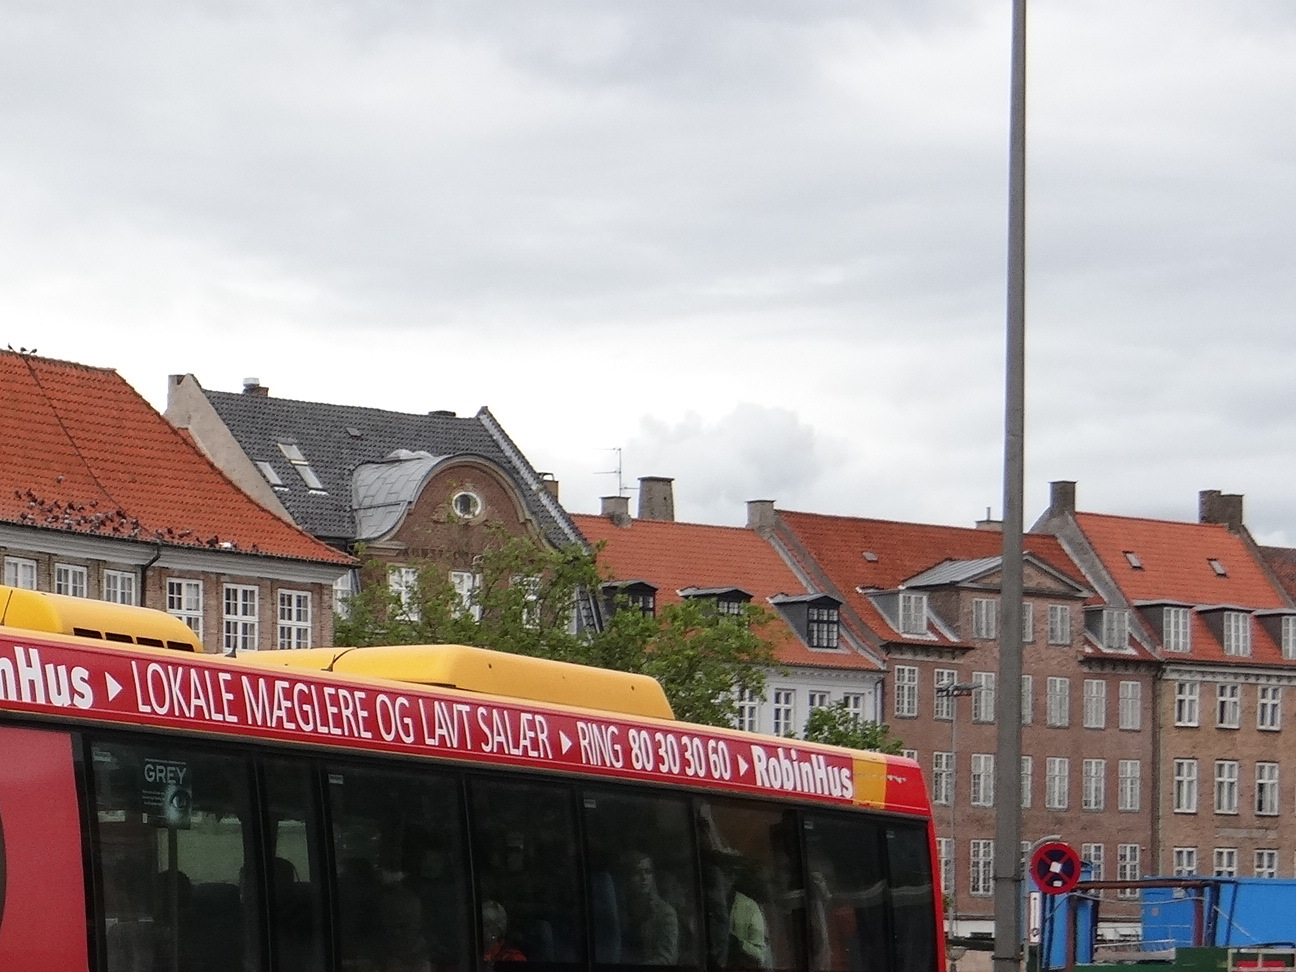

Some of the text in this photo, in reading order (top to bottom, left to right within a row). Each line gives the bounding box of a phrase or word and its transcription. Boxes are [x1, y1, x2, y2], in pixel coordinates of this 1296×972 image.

[131, 660, 238, 723] LOKALE
[241, 676, 373, 739] MÆGLERE
[376, 693, 415, 745] OG
[418, 698, 472, 750] LAVT
[476, 706, 553, 760] SALÆR
[576, 721, 623, 769] RING
[628, 728, 653, 772] 80
[655, 732, 680, 775] 30
[681, 736, 706, 778] 30
[707, 739, 732, 782] 60
[751, 744, 854, 800] RobinHus
[144, 763, 187, 785] GREY
